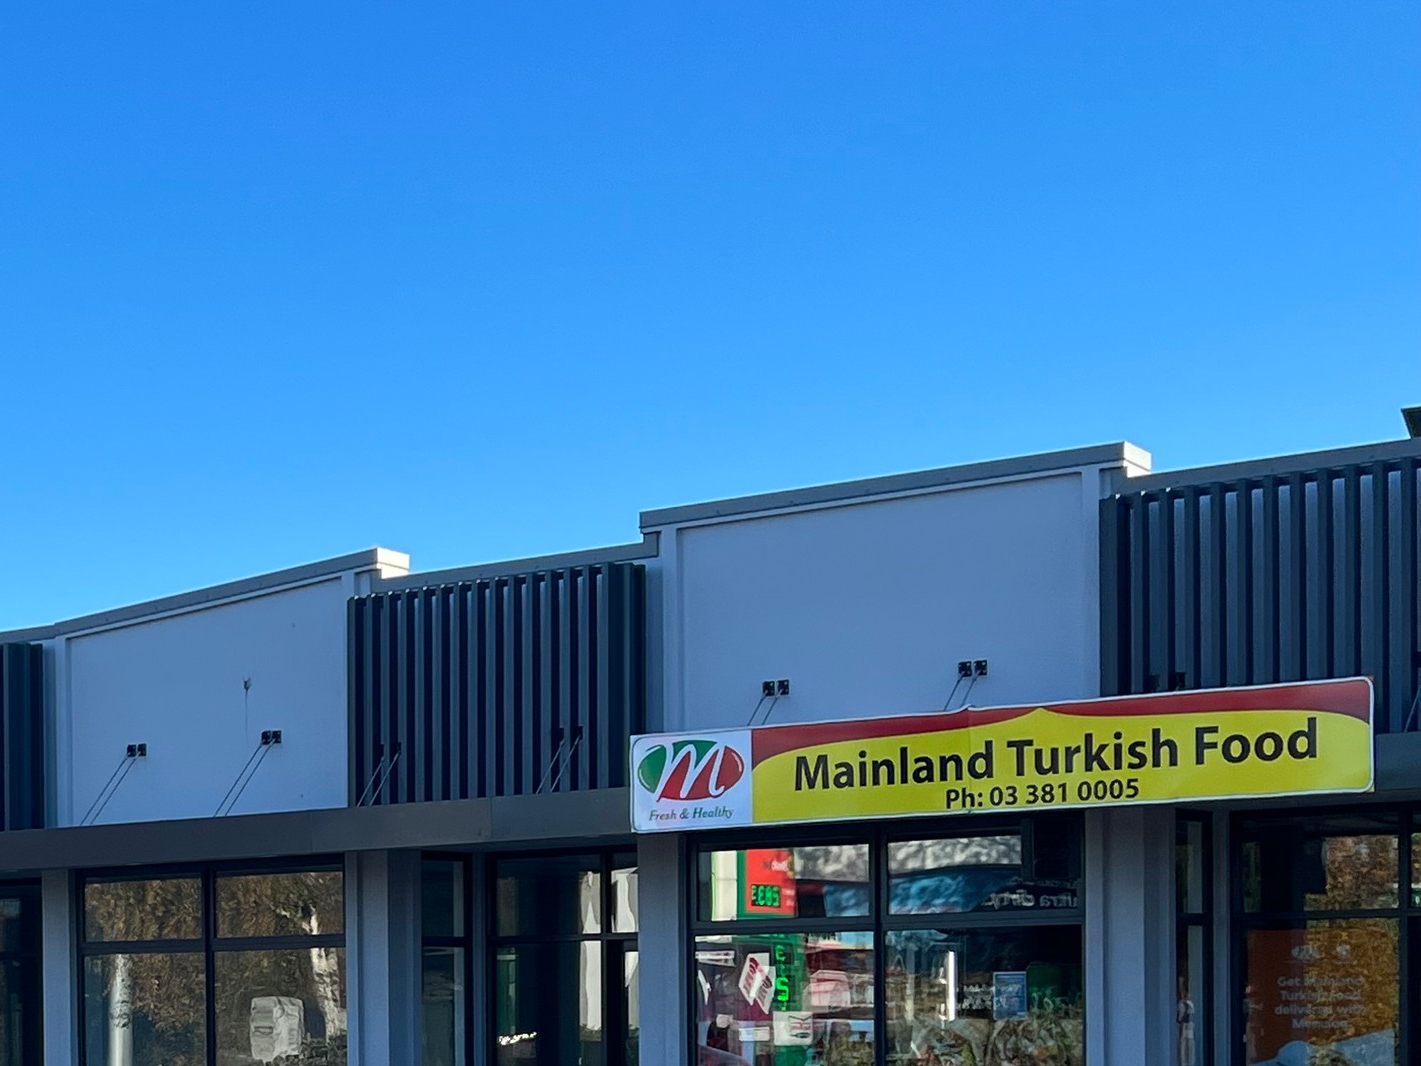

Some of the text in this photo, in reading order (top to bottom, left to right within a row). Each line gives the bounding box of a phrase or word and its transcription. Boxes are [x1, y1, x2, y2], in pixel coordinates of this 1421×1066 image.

[794, 717, 1318, 791] Mainland Turkish Food
[946, 778, 1139, 809] Ph: 03 381 0005
[648, 805, 734, 821] Fresh & Healthy
